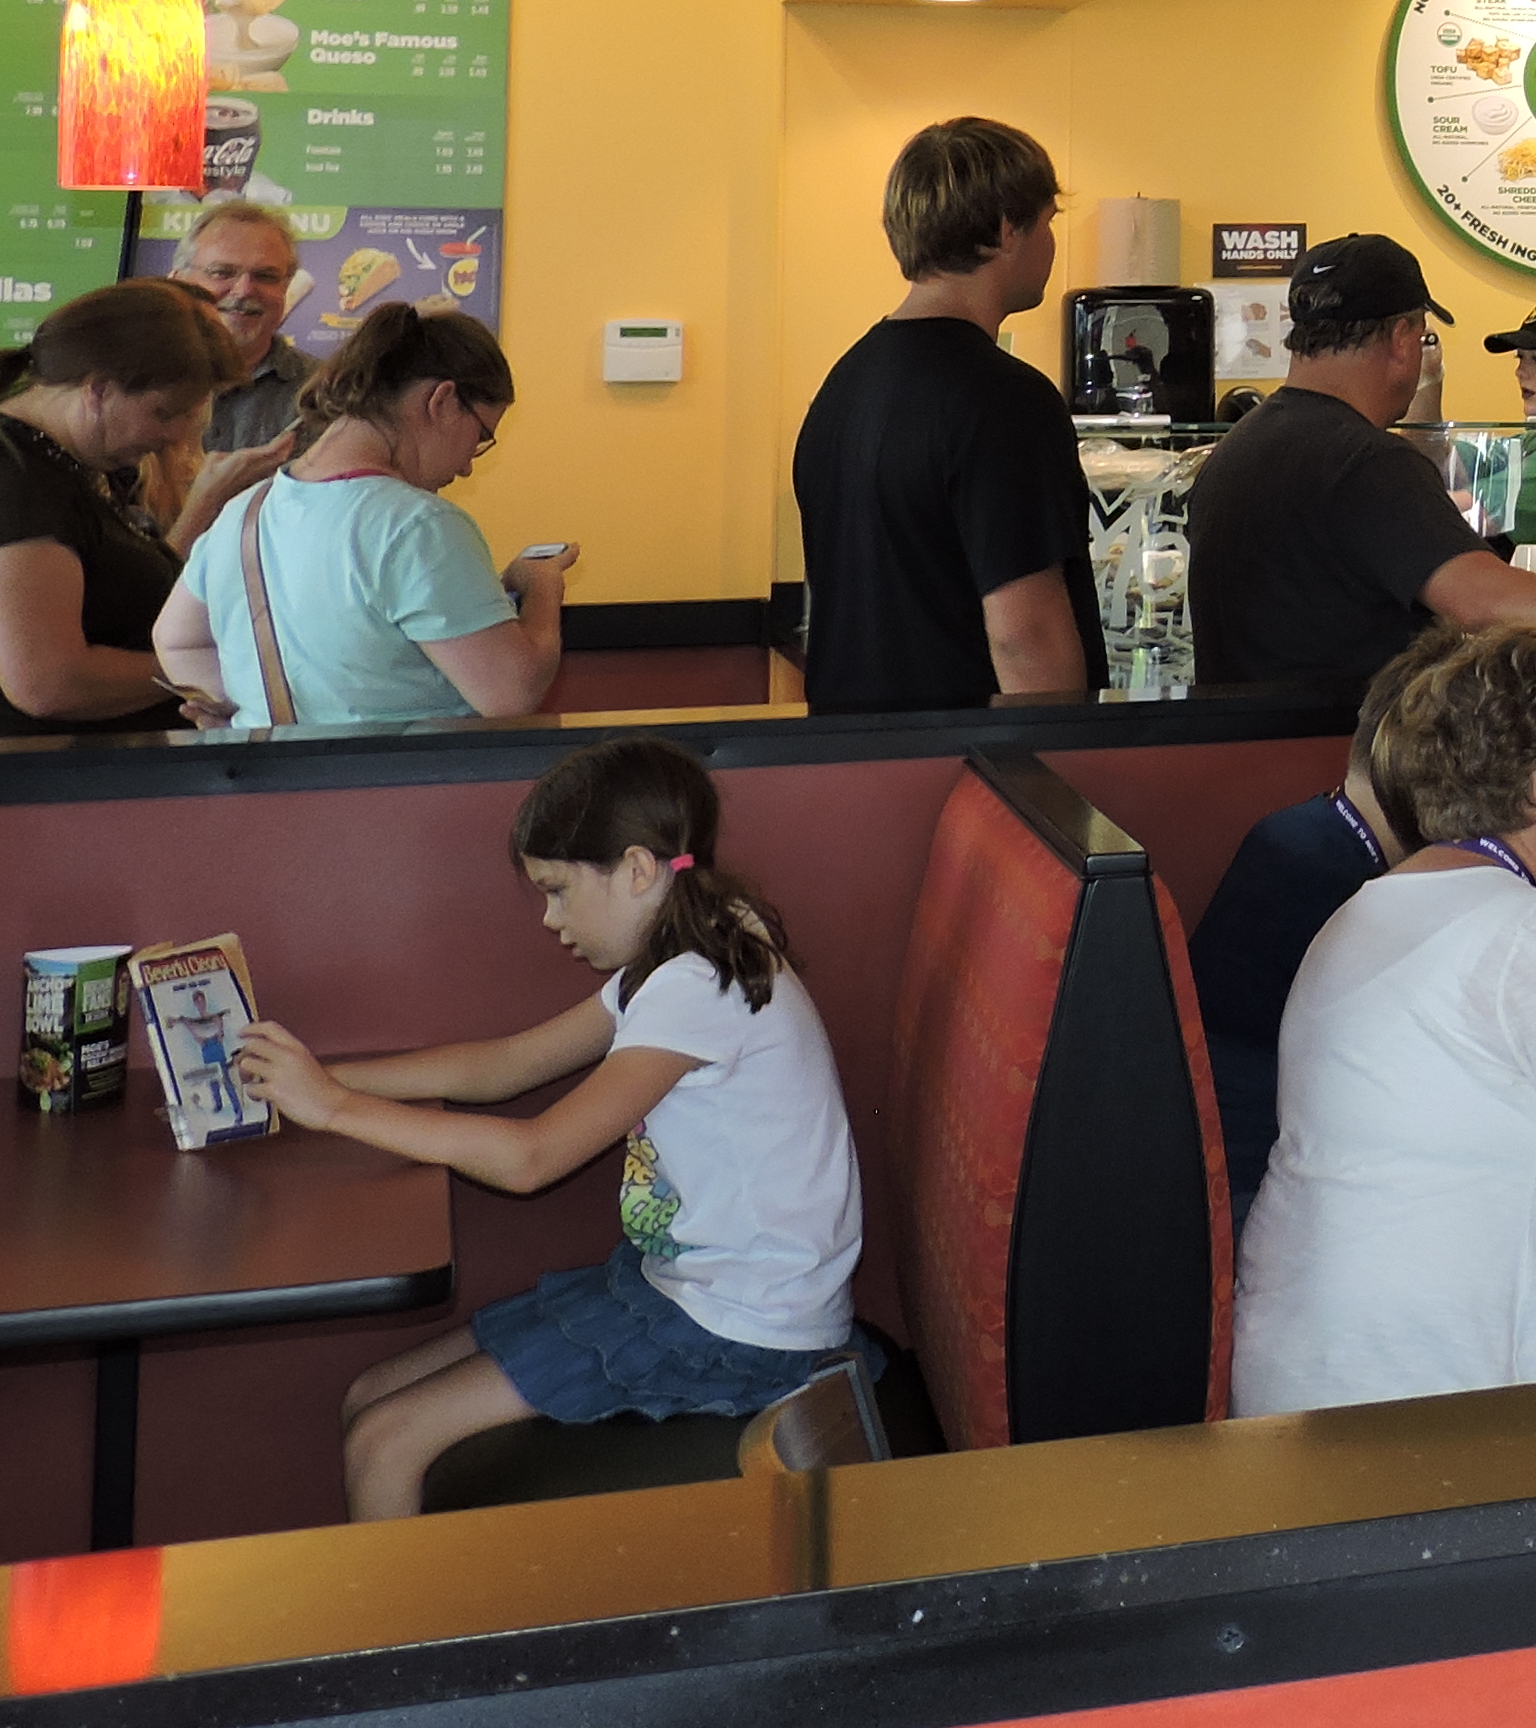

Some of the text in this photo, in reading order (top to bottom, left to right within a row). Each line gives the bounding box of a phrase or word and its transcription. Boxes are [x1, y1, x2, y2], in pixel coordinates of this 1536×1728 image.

[310, 29, 459, 49] Moe's Famous
[310, 48, 376, 65] Queso
[1430, 65, 1457, 74] TOFU
[307, 108, 375, 126] Drinks
[1433, 116, 1460, 124] SOUR
[1432, 125, 1468, 133] CREAM
[163, 212, 331, 233] KI NU
[1436, 184, 1462, 212] 20+
[1460, 210, 1510, 249] FRESH
[1221, 230, 1298, 249] WASH
[1221, 249, 1298, 260] HANDS ONLY
[1335, 799, 1359, 830] WELCOME
[1356, 828, 1367, 840] TO
[1479, 836, 1520, 872] WELCOME
[142, 957, 188, 986] Beverly
[27, 991, 64, 1015] LIME
